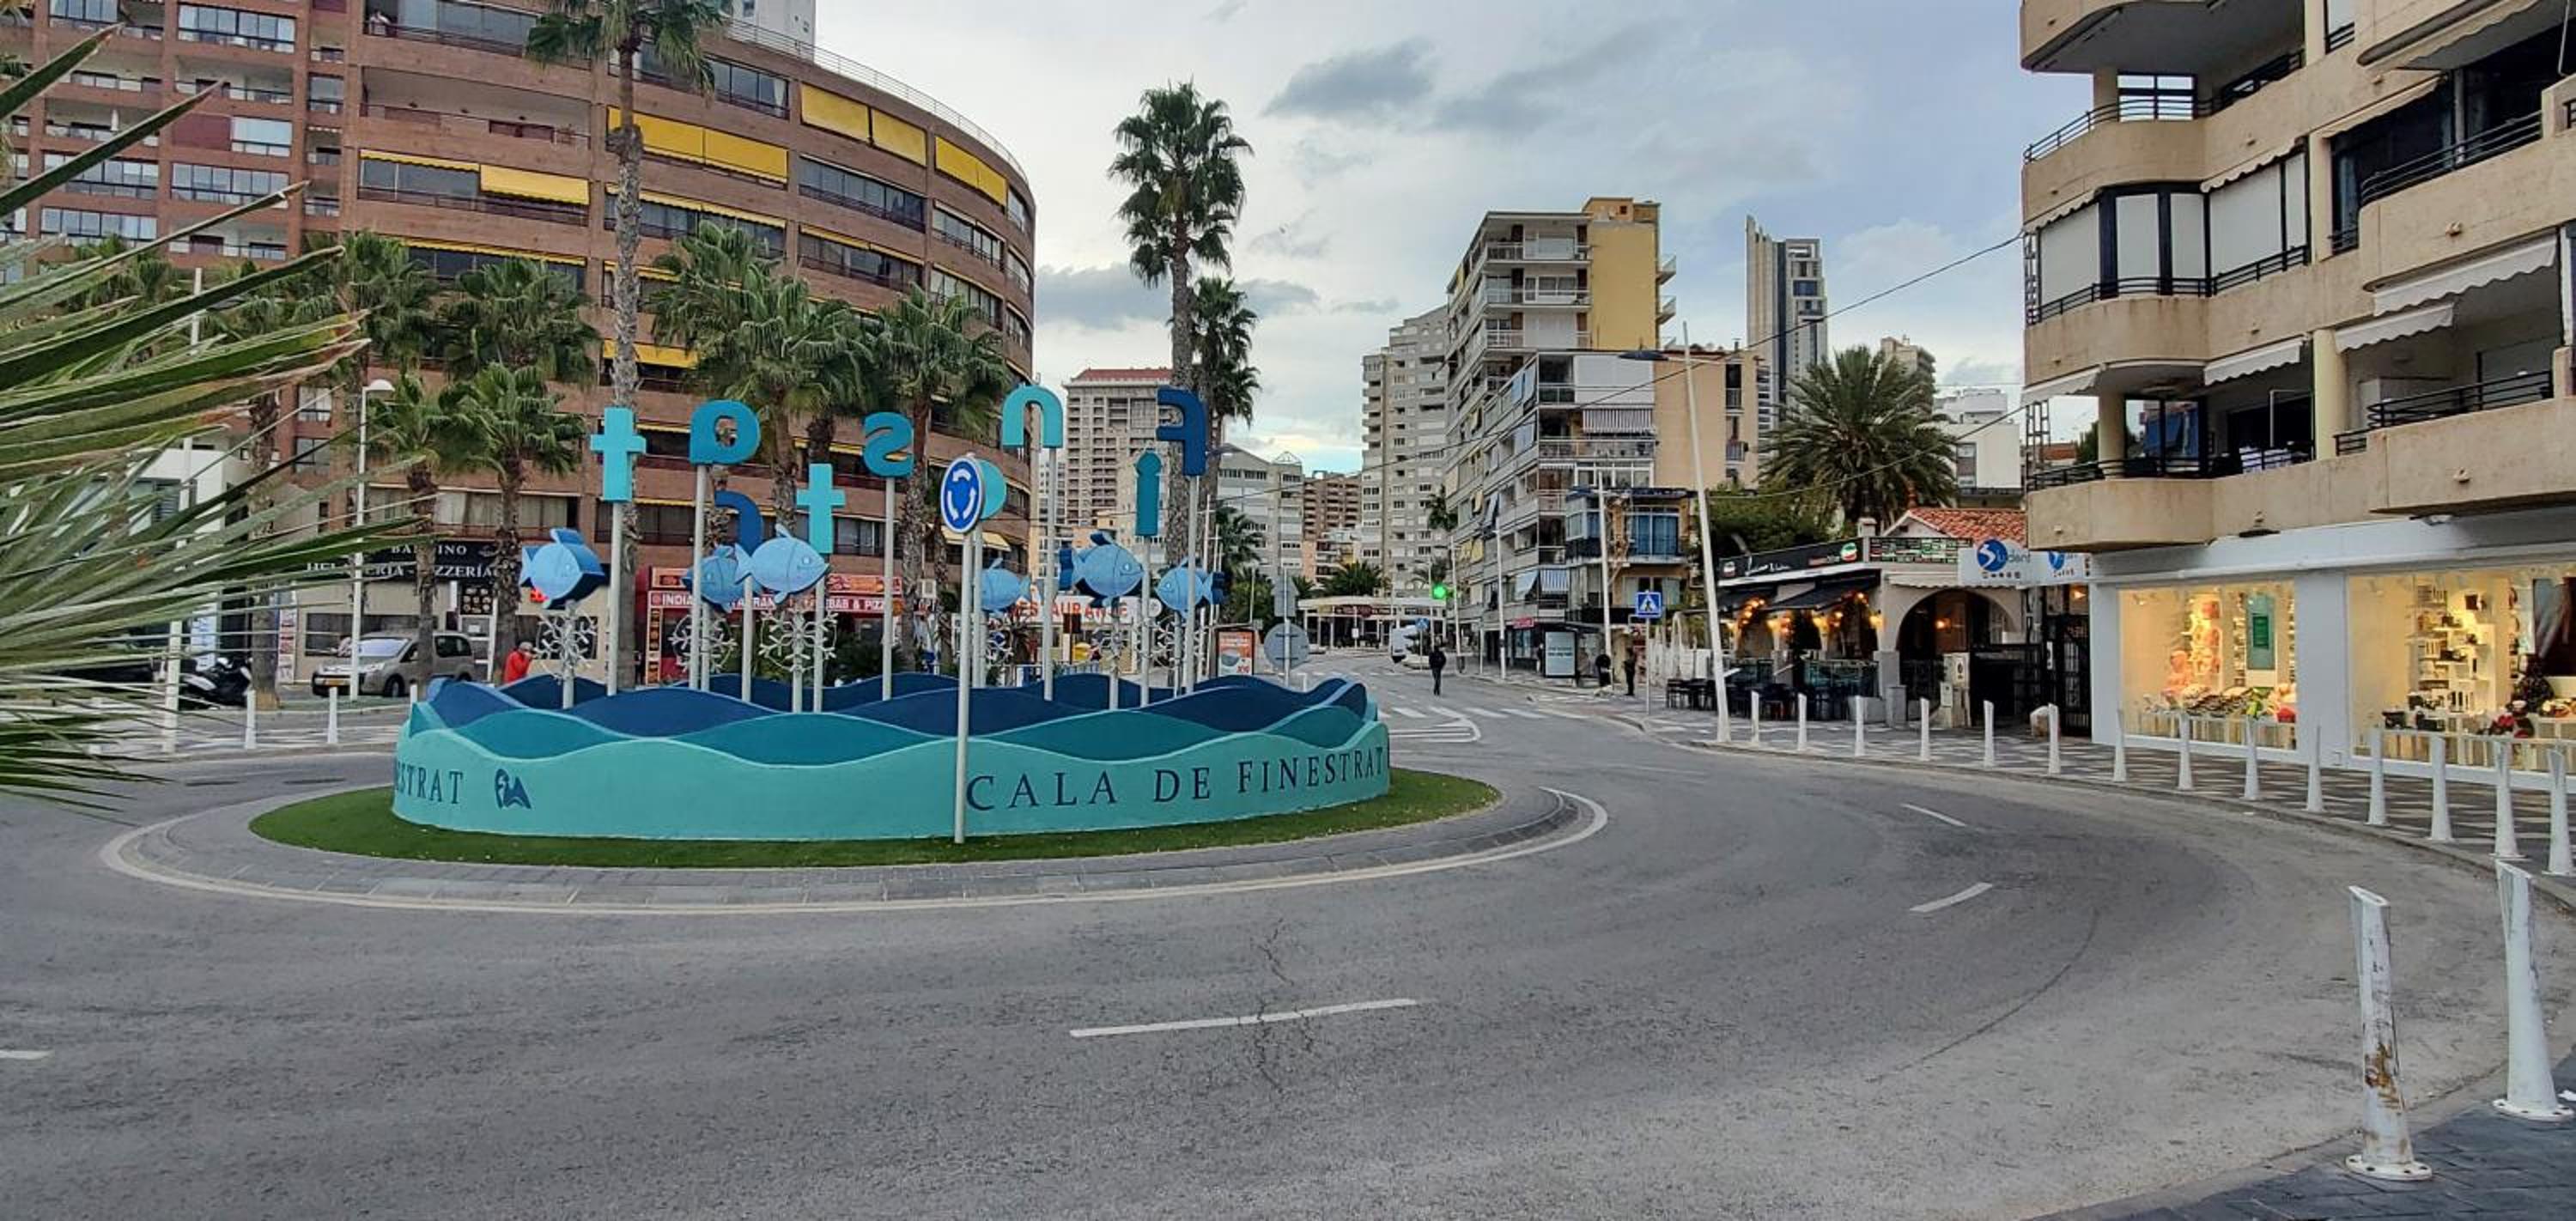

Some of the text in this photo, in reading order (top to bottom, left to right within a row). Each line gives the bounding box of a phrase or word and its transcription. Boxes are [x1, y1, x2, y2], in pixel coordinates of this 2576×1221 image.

[966, 746, 1384, 811] CALA DE FINESTRAT
